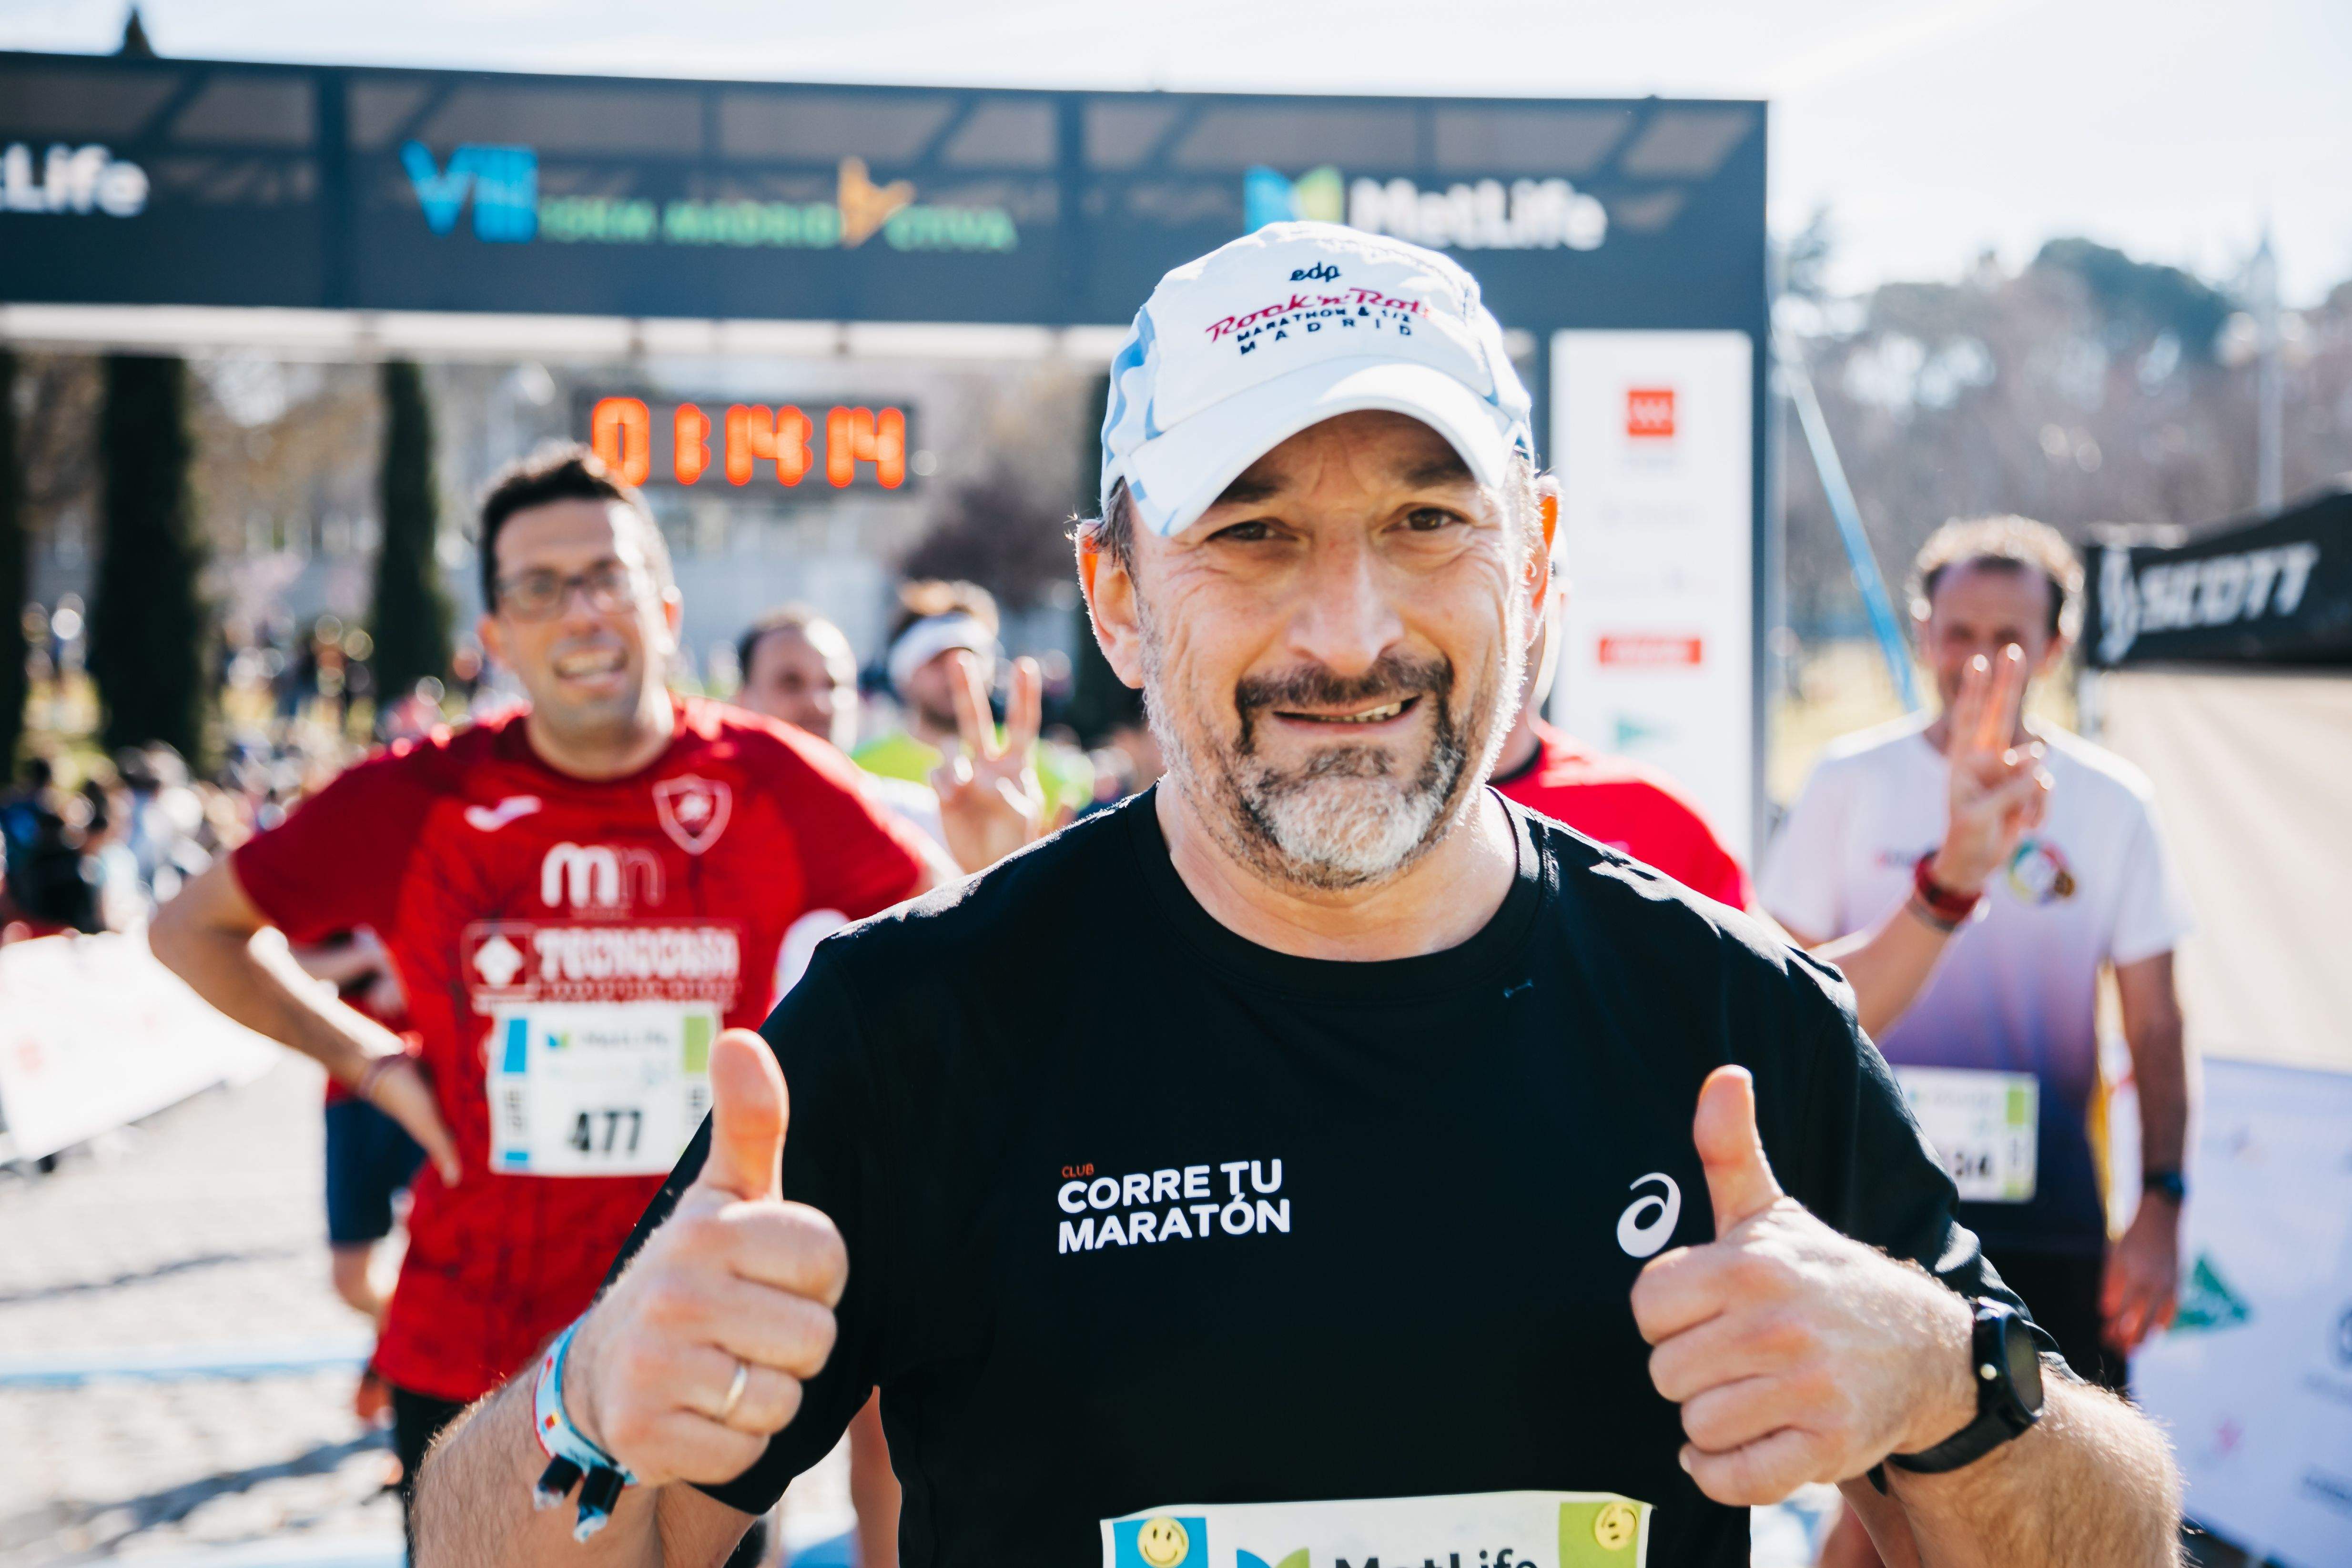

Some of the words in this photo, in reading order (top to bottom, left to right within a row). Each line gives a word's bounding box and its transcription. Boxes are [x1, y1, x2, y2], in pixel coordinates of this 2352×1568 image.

[0, 141, 150, 218] Life
[1350, 177, 1607, 252] MetLife
[1289, 261, 1342, 282] edp
[1237, 307, 1347, 342] MARATHON
[1358, 305, 1370, 316] &
[1240, 316, 1412, 355] MADRID
[2139, 540, 2321, 634] SCOTT
[567, 1109, 642, 1153] 477
[1057, 1165, 1211, 1214] CORRE
[1220, 1159, 1282, 1195] TU
[1061, 1163, 1095, 1178] CLUB
[1058, 1192, 1290, 1254] MARATÓN
